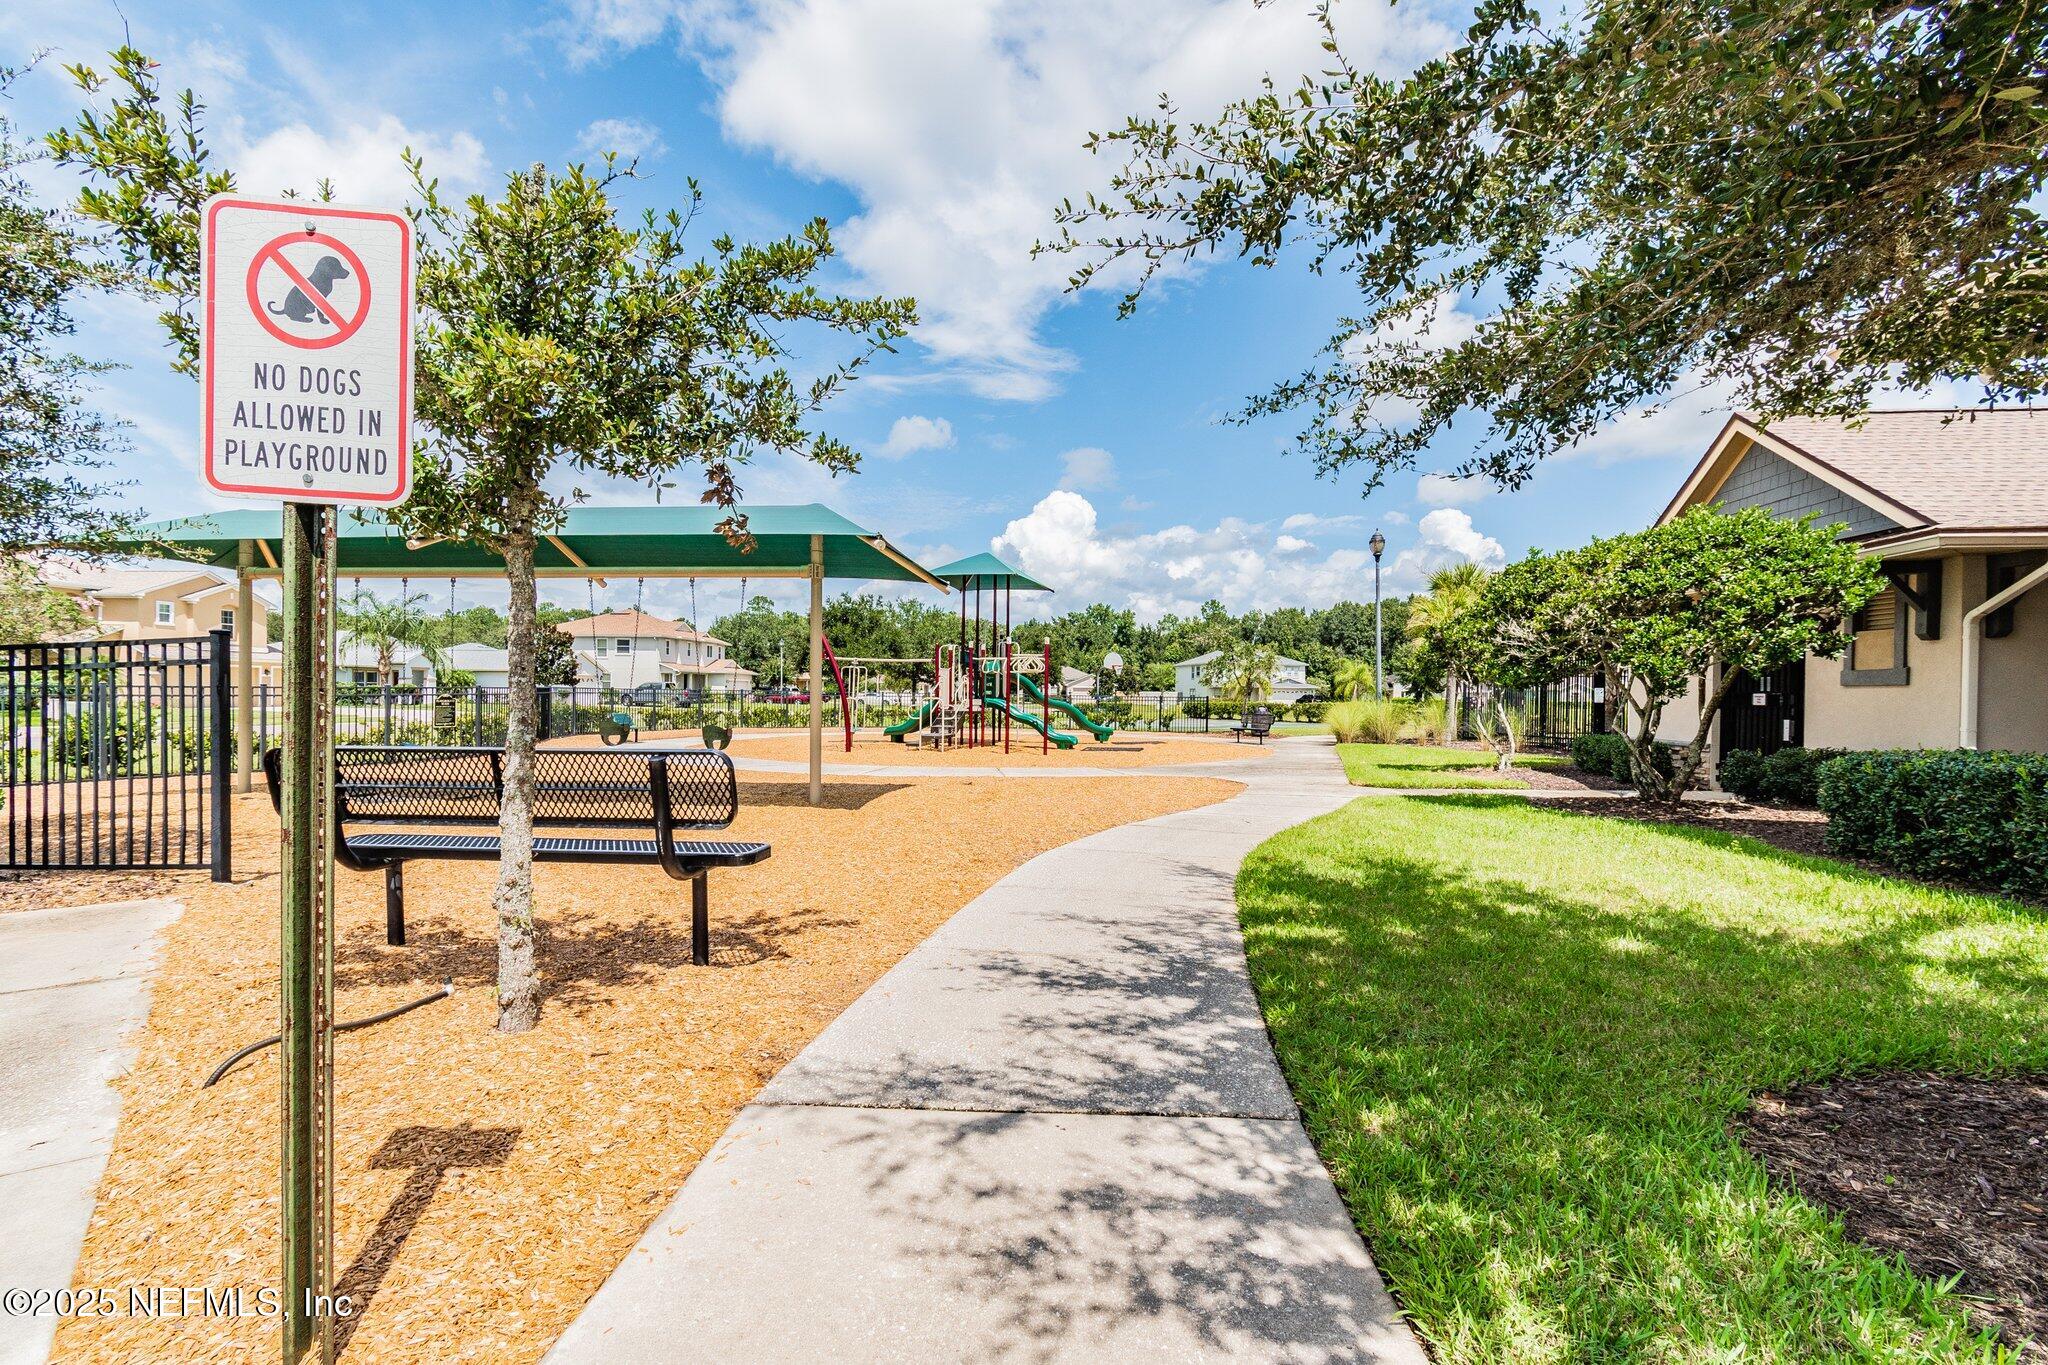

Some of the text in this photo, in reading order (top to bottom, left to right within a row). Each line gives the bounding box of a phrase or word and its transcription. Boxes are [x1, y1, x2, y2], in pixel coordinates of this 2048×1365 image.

[254, 362, 362, 397] NO DOGS
[232, 401, 382, 437] ALLOWED IN
[225, 439, 387, 476] PLAYGROUND
